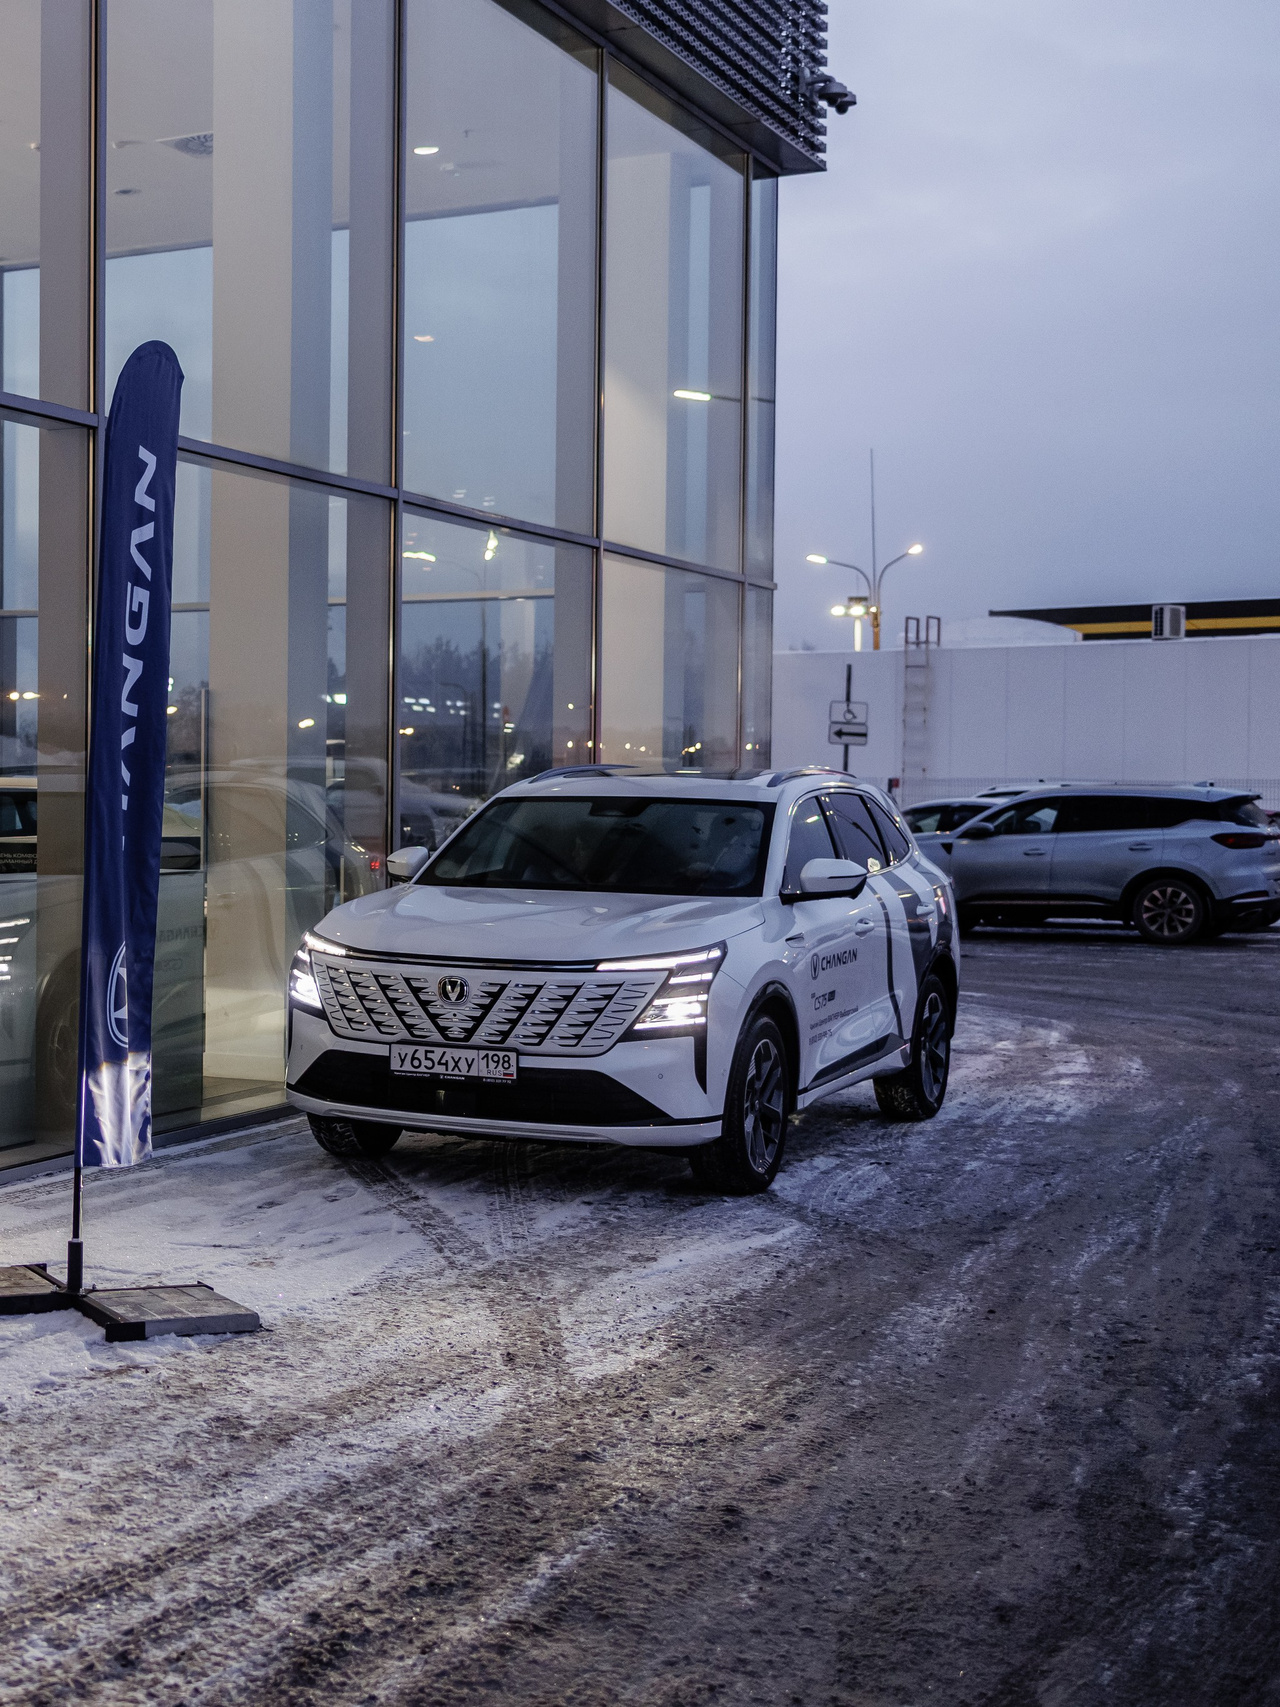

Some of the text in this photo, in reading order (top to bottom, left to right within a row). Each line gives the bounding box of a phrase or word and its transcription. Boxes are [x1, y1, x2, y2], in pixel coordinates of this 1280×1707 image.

[120, 444, 158, 851] ANGAN
[821, 948, 858, 971] CHANGAN
[481, 1053, 511, 1070] 198
